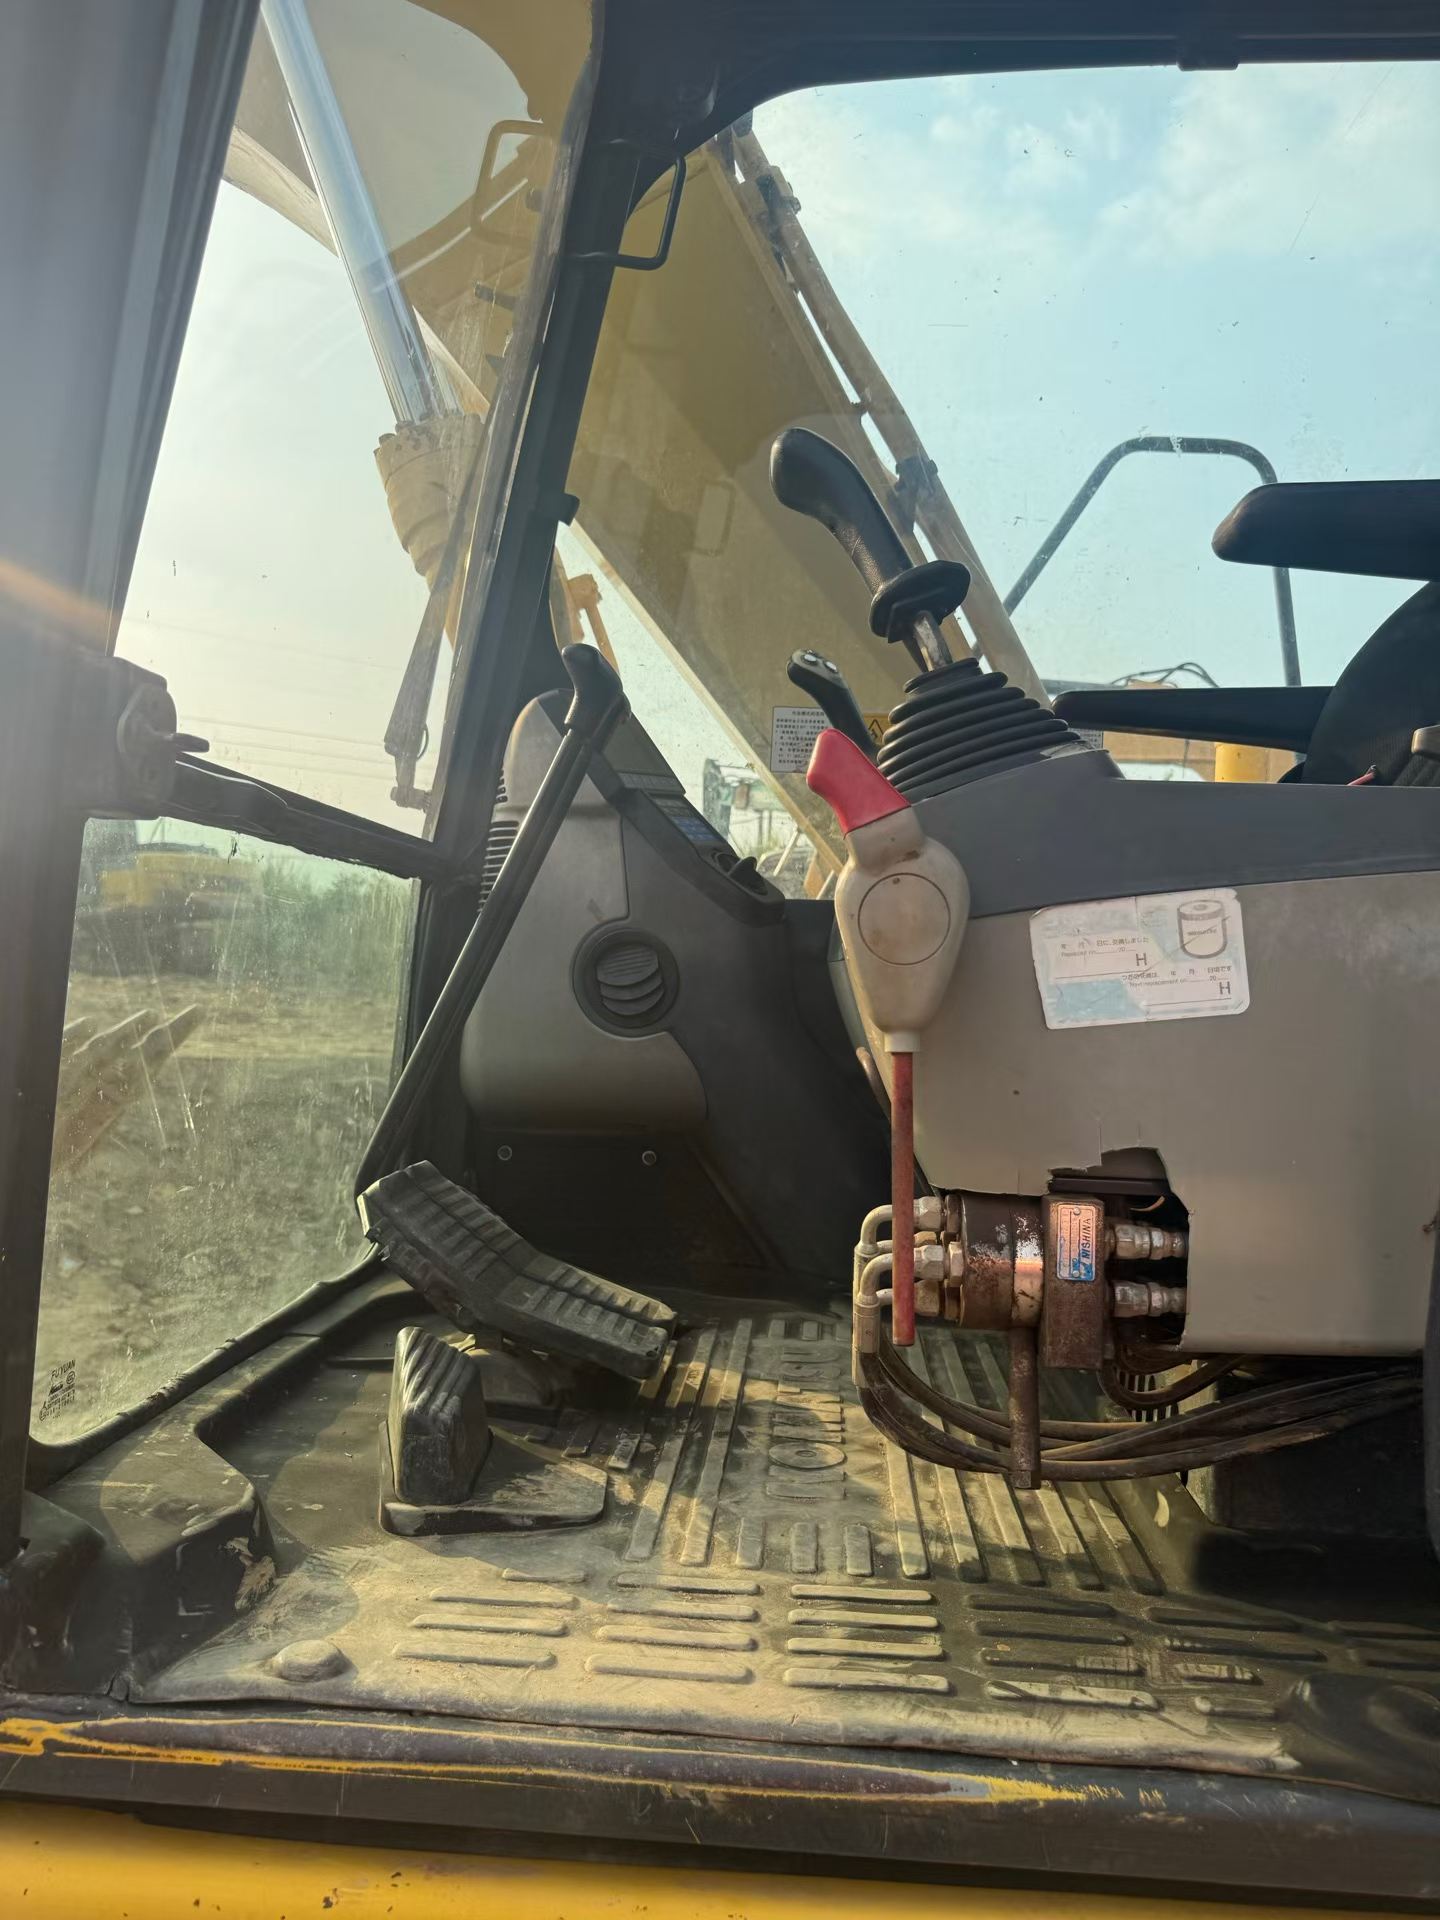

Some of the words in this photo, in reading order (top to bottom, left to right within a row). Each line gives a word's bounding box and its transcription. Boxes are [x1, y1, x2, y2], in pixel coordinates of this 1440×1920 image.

[1135, 952, 1148, 967] H
[1218, 981, 1232, 995] H
[1082, 1218, 1091, 1260] NISHINA
